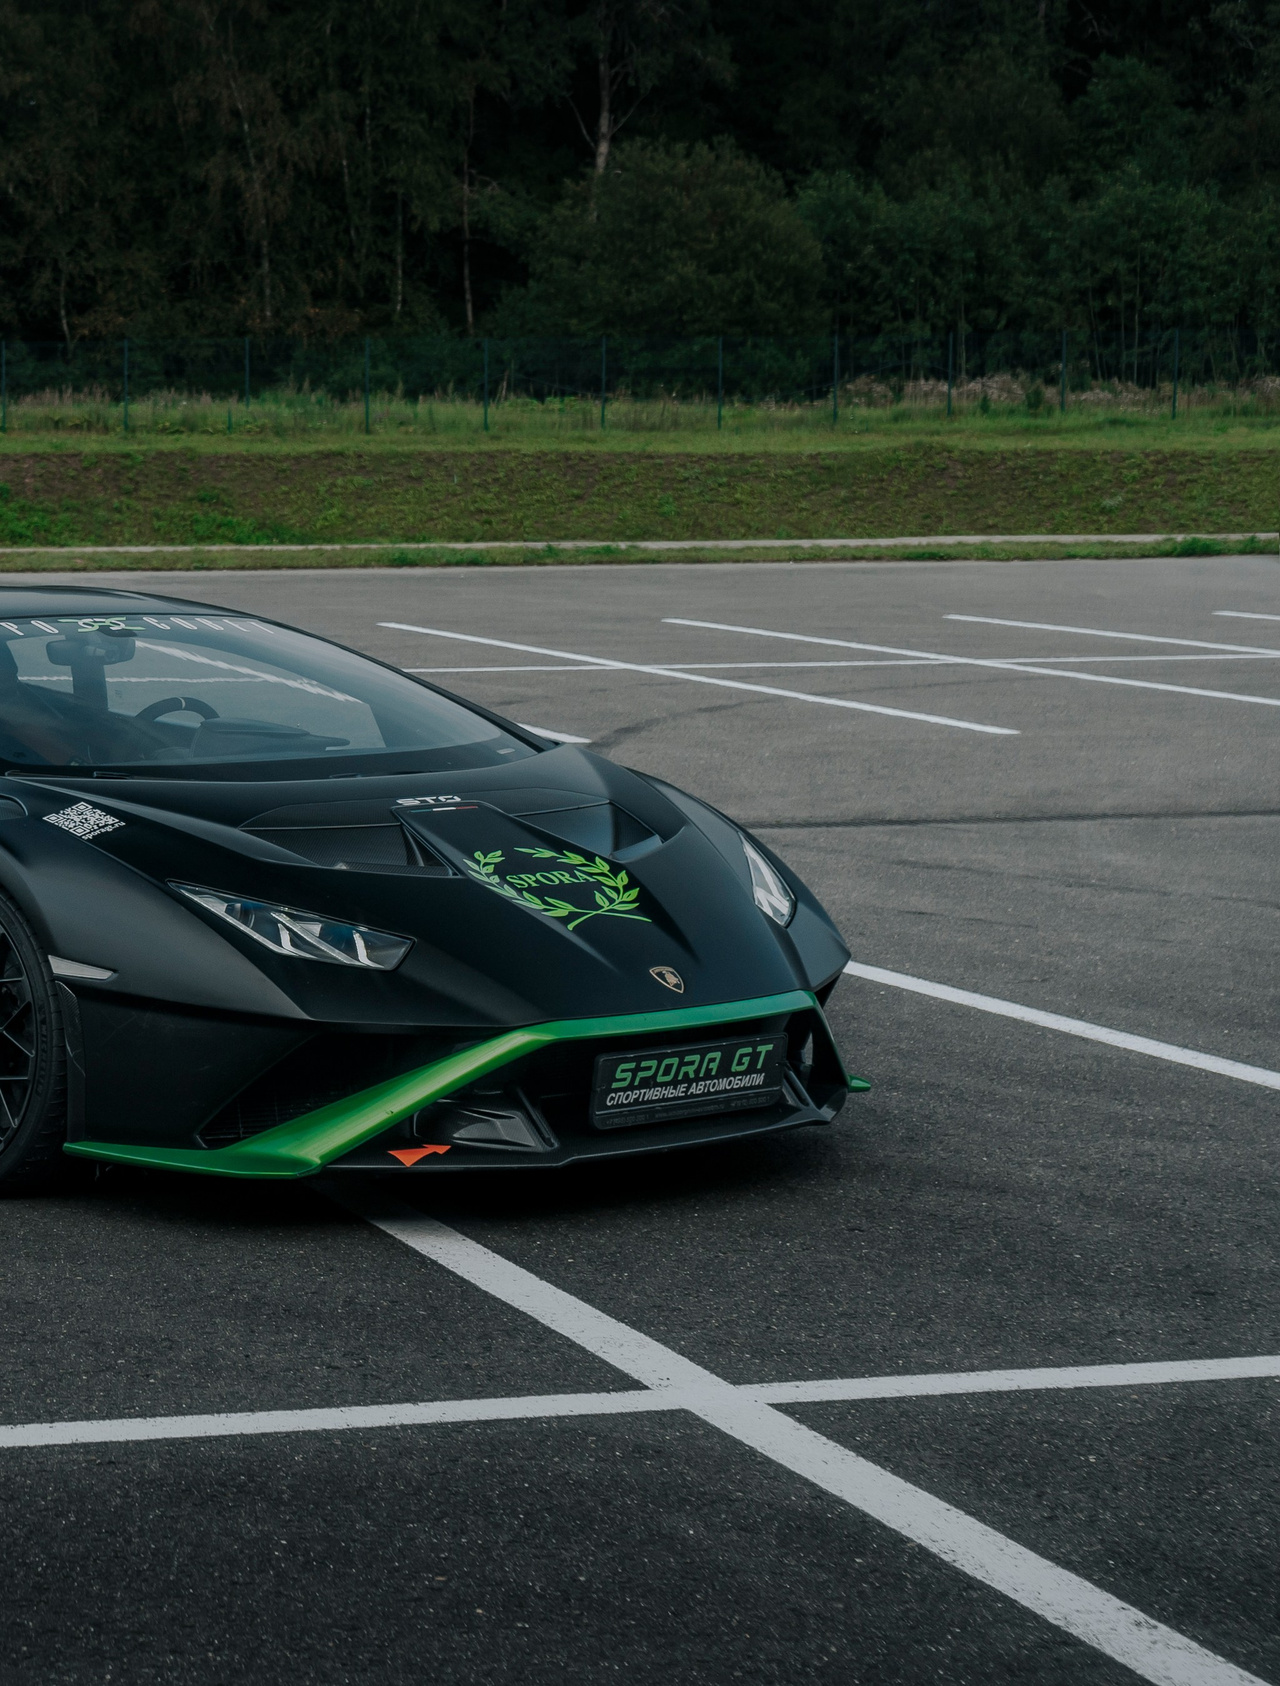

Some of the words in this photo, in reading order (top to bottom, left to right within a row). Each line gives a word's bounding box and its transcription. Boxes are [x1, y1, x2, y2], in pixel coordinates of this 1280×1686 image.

[395, 795, 461, 806] STO
[505, 869, 598, 889] SPORA
[611, 1051, 722, 1089] SPORA
[730, 1043, 774, 1073] GT
[606, 1084, 687, 1106] СПОРТИВНЫЕ
[687, 1072, 766, 1095] АВТОМОБИЛИ
